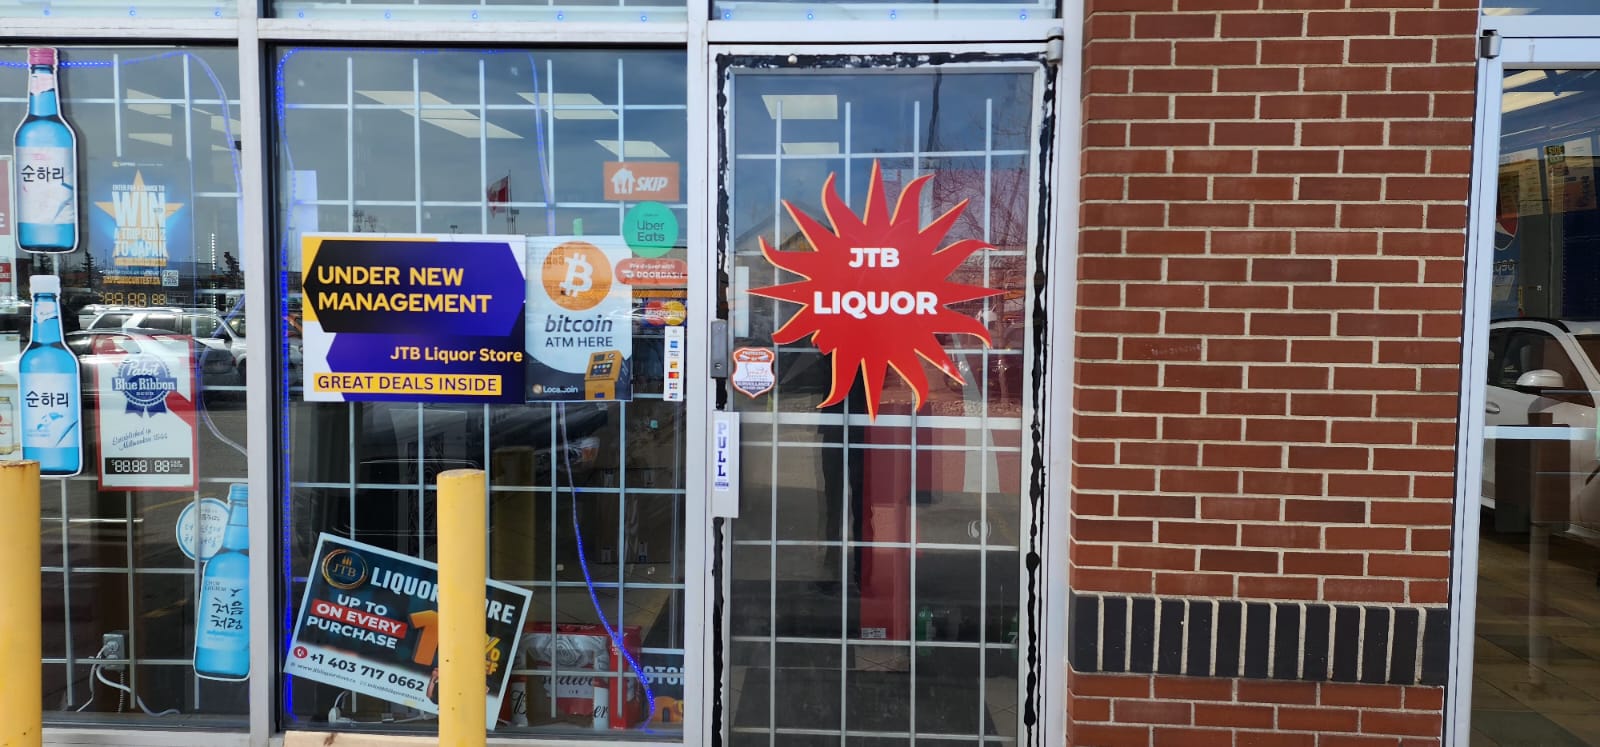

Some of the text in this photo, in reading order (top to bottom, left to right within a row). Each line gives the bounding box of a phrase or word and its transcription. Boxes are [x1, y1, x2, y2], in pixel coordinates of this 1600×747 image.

[20, 164, 65, 183] 순하리
[635, 176, 669, 192] SKIP
[112, 191, 166, 228] WIN
[636, 219, 665, 231] Uber
[637, 231, 665, 242] Eats
[848, 247, 900, 269] JTB
[317, 265, 464, 287] UNDER NEW
[318, 291, 493, 313] MANAGEMENT
[813, 291, 938, 320] LIQUOR
[544, 313, 613, 333] bitcoin
[545, 336, 613, 348] ATM HERE
[389, 345, 523, 364] JTB Liquor Store
[127, 360, 160, 376] Pabst
[115, 377, 175, 391] Blue Ribbon
[317, 375, 497, 392] GREAT DEALS INSIDE
[25, 391, 69, 408] 순하리
[716, 422, 728, 477] PULL
[331, 561, 357, 579] JTB
[337, 594, 388, 616] UP TO
[316, 603, 403, 635] ON EVERY
[306, 616, 398, 650] PURCHASE
[310, 653, 425, 692] +1 403 717 0662
